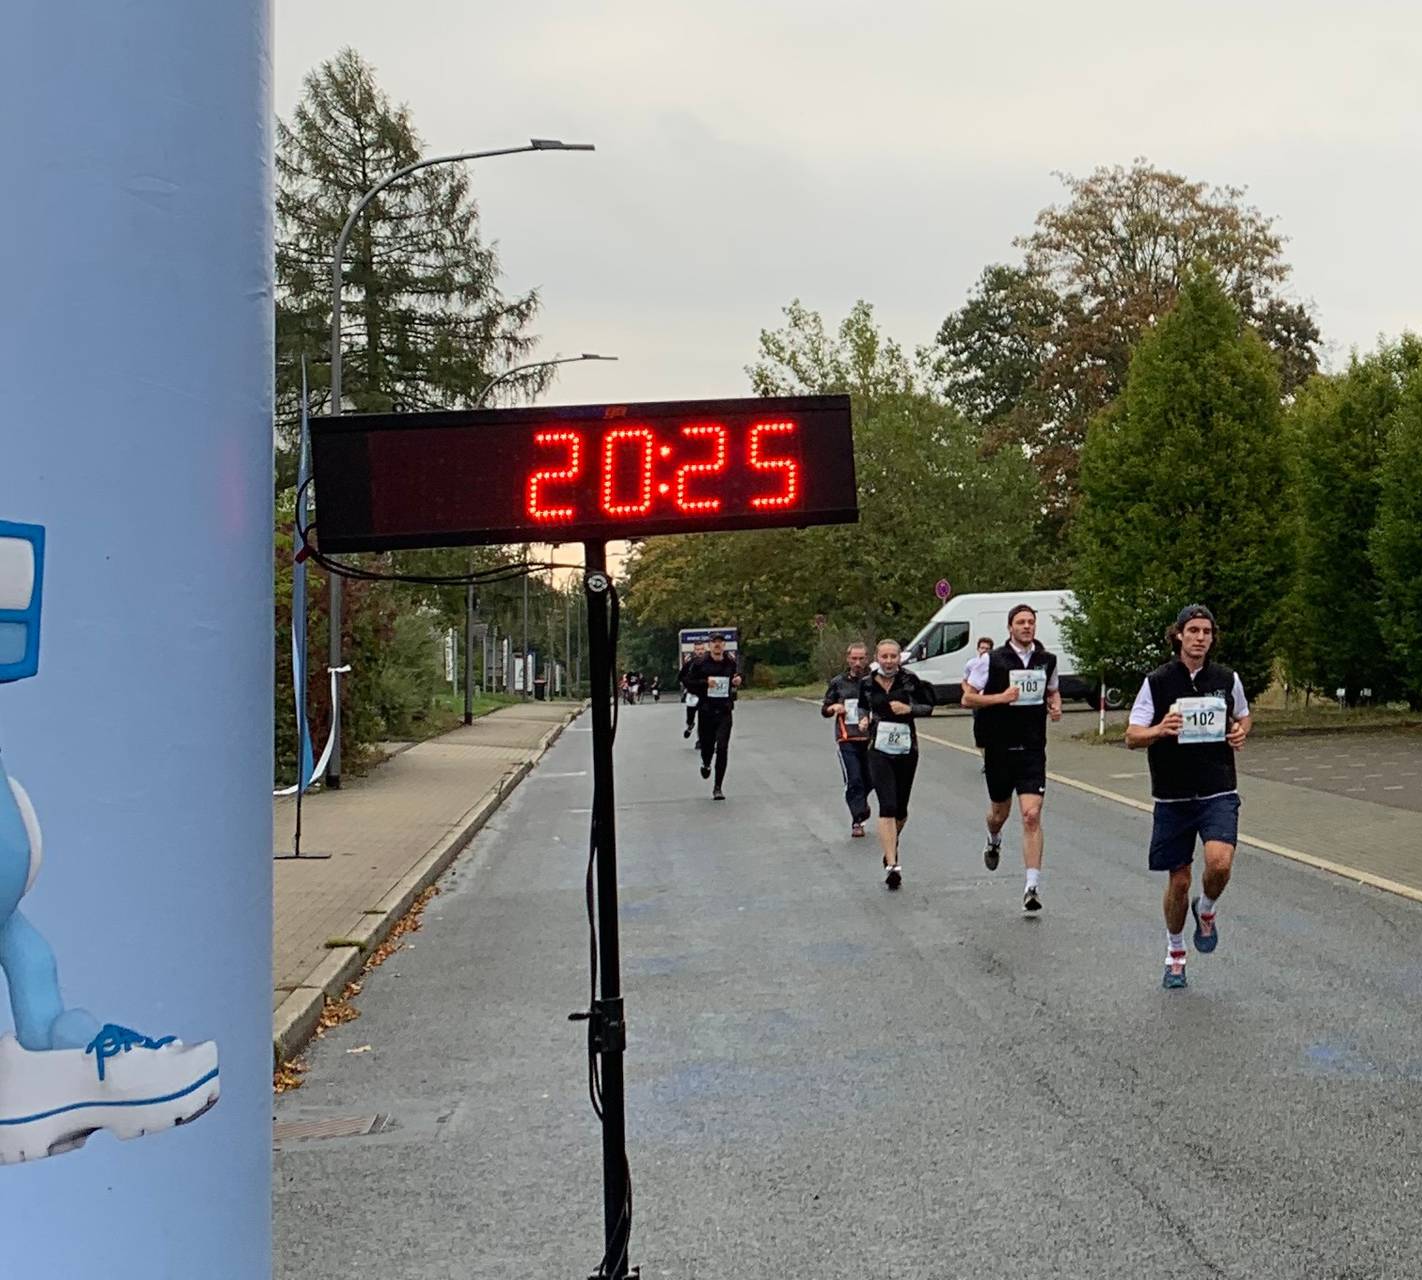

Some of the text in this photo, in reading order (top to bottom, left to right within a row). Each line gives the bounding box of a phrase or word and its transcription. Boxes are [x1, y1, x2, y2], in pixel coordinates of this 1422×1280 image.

[526, 420, 797, 519] 20:25
[1021, 680, 1038, 693] 103
[1192, 711, 1215, 726] 102
[888, 732, 901, 744] 82
